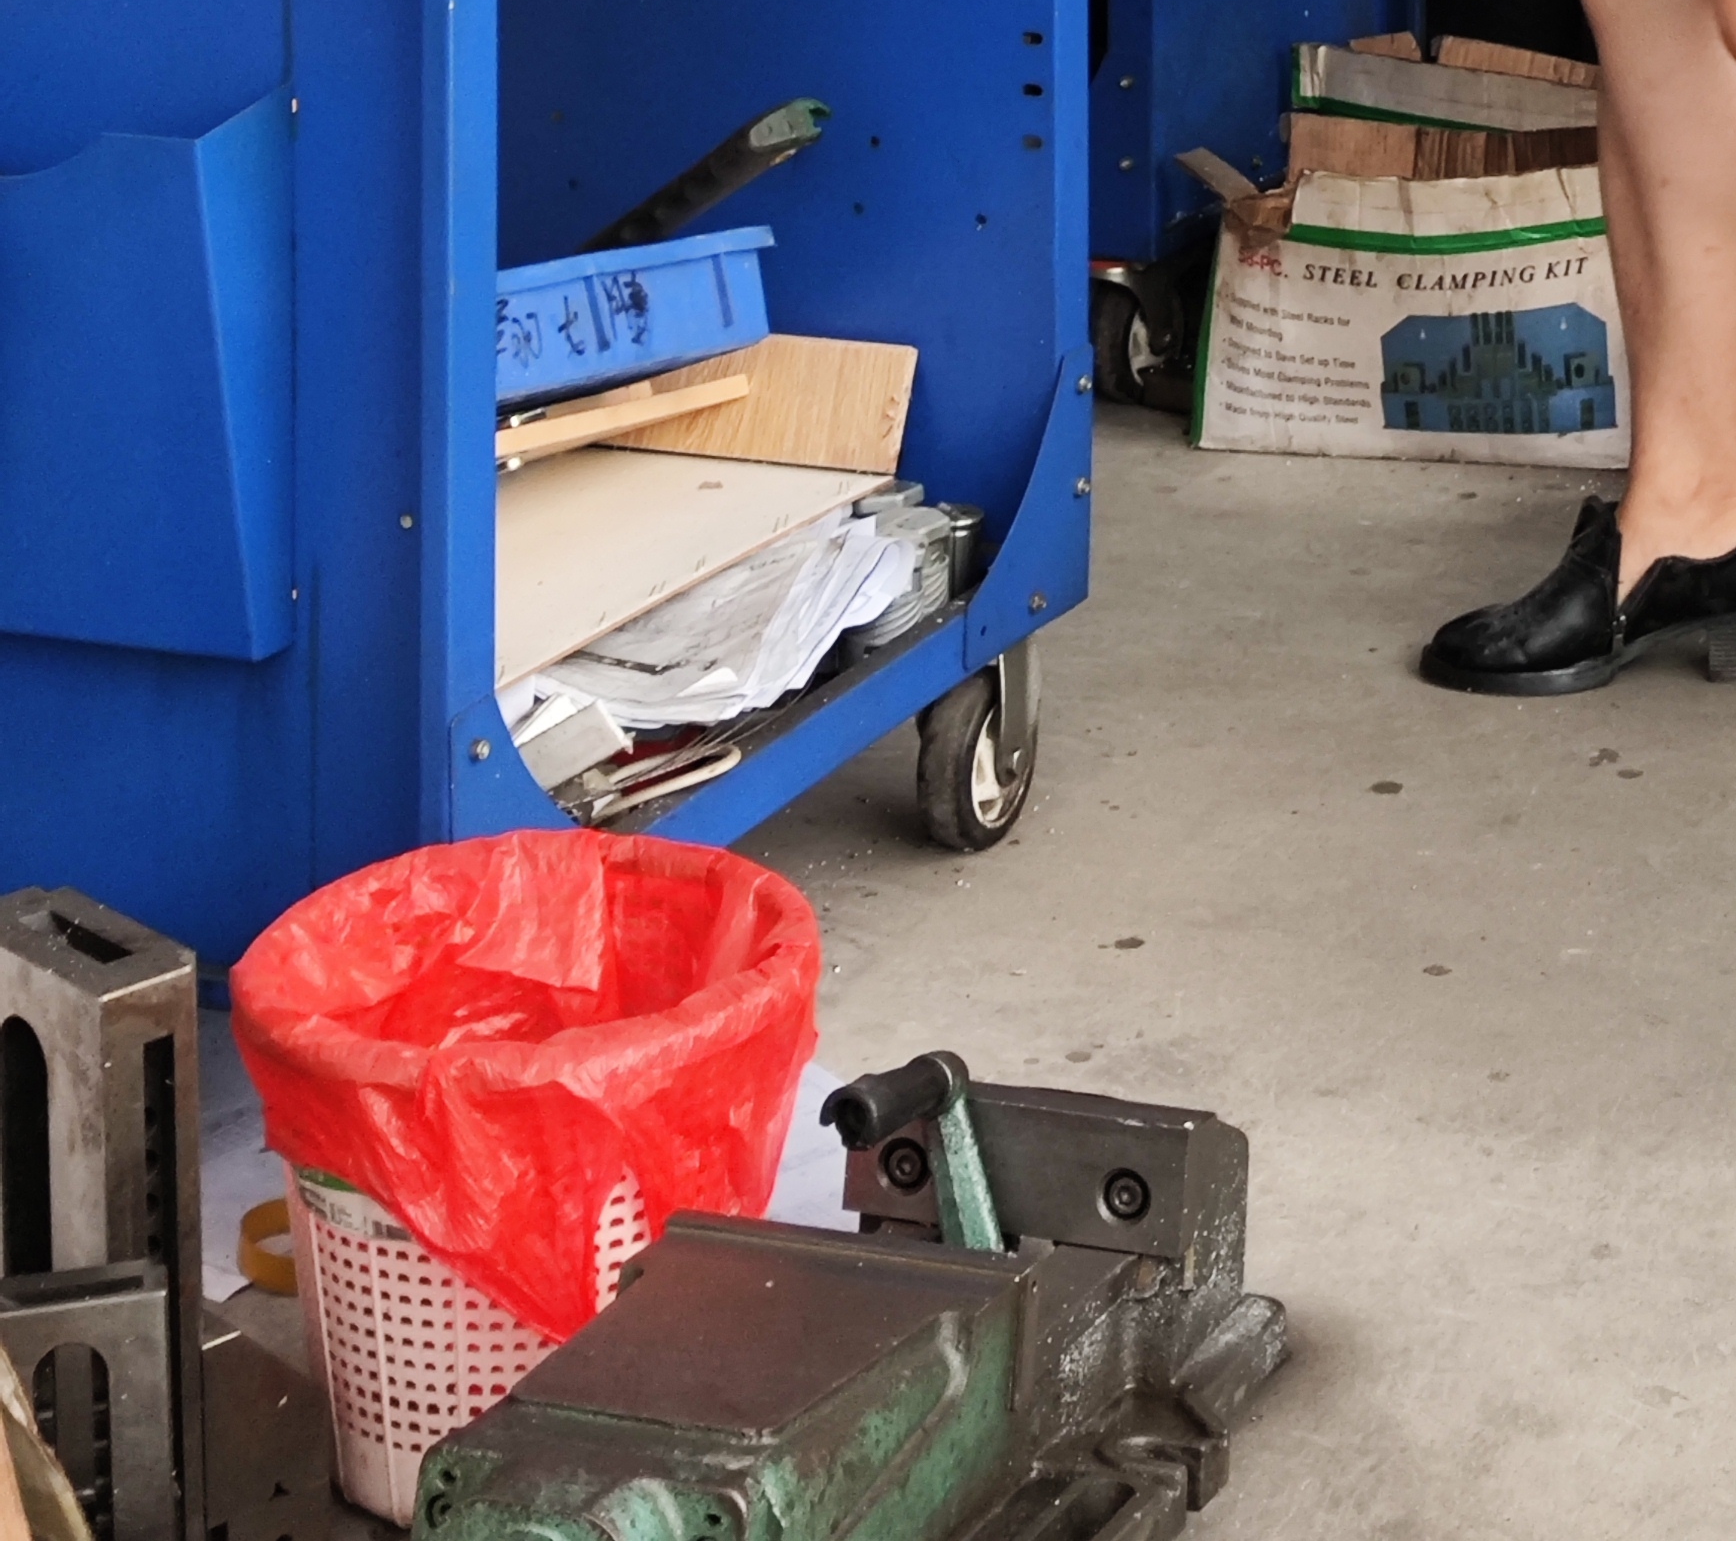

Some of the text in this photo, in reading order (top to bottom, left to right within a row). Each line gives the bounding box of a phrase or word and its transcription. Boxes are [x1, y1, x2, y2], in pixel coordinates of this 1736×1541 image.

[1303, 263, 1378, 288] STEEL
[1396, 265, 1536, 291] CLAMPING
[1545, 257, 1589, 280] KIT
